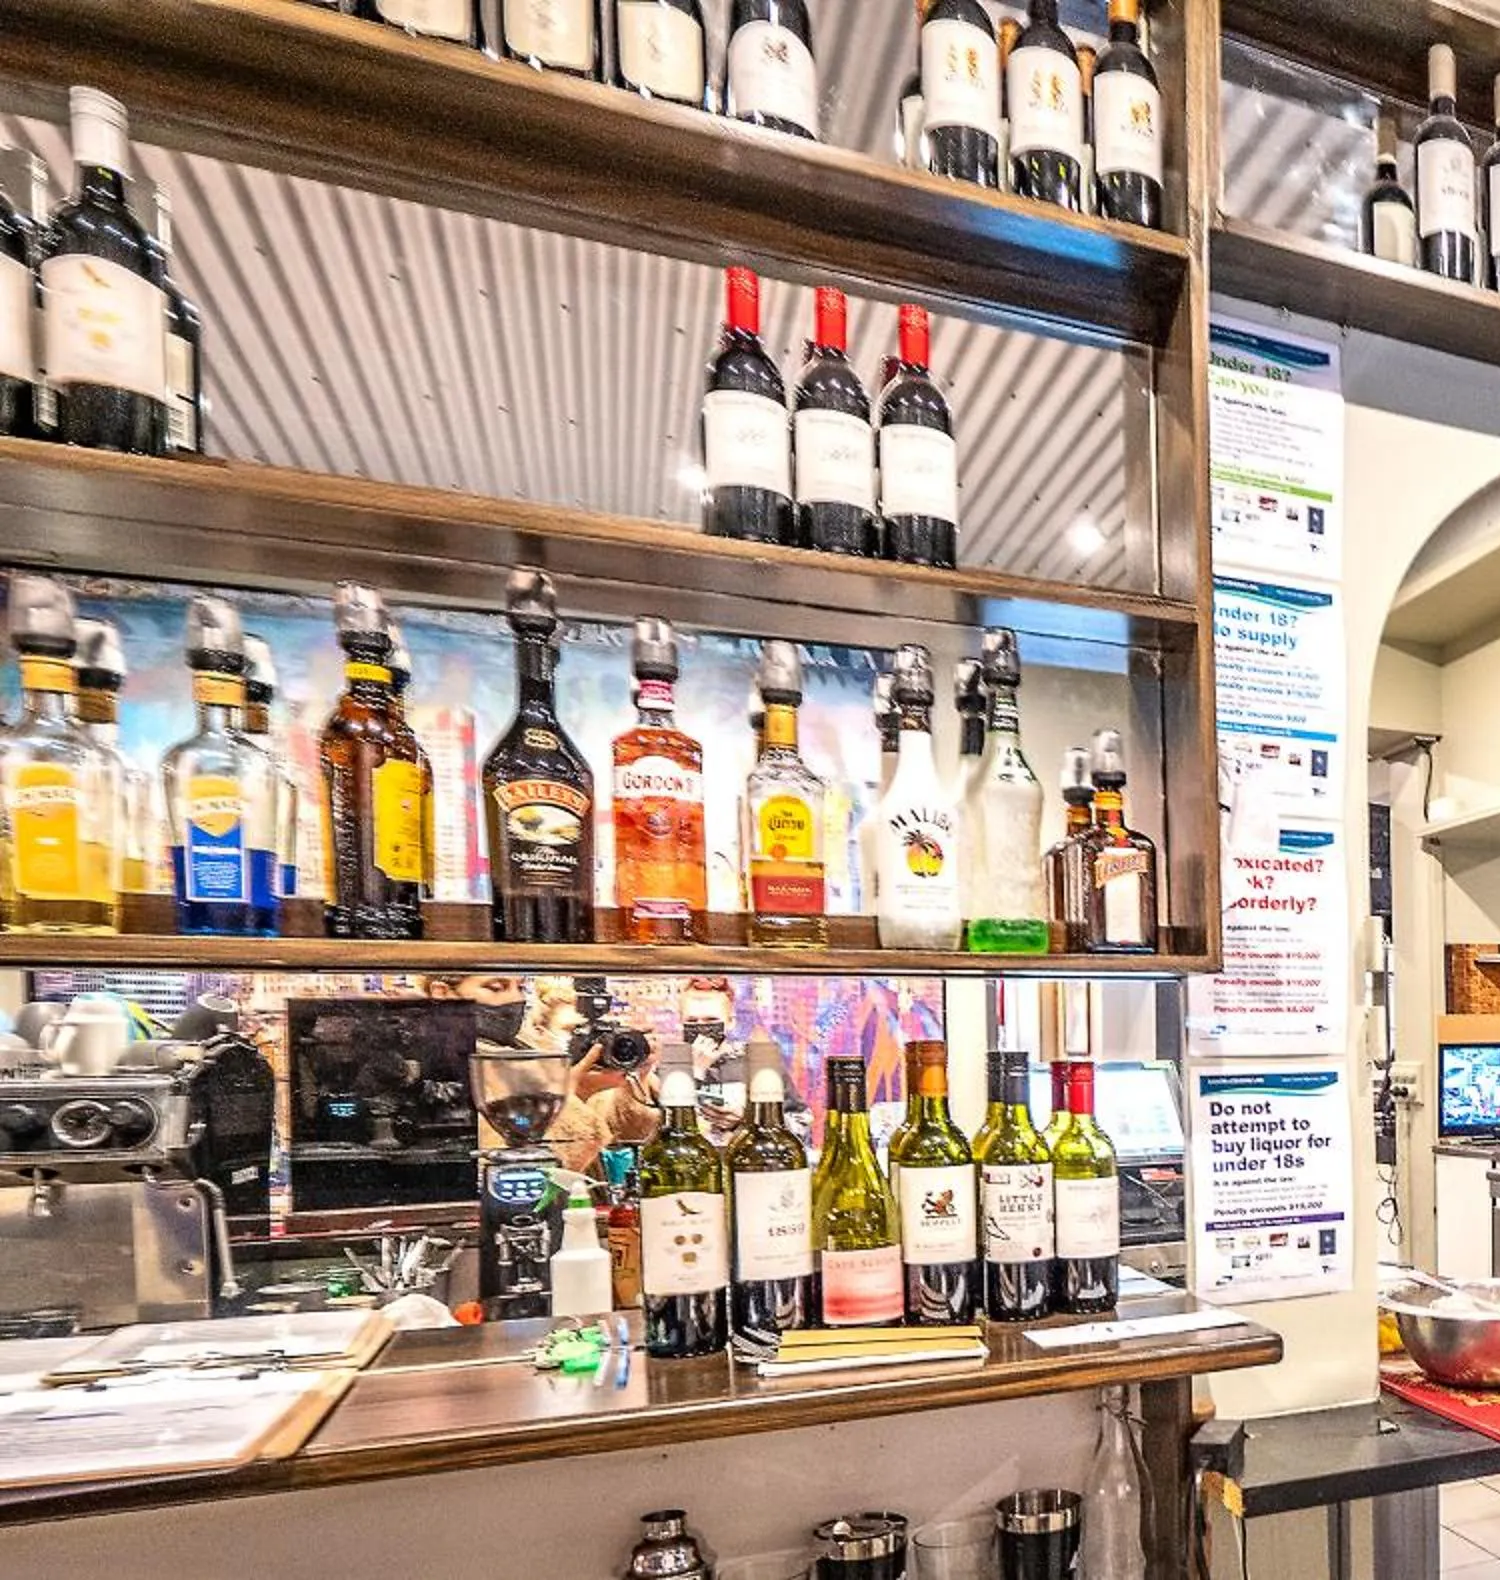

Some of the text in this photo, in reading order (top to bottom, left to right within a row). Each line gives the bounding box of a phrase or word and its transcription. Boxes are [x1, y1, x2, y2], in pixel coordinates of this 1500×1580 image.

[1270, 611, 1298, 629] 18?
[1236, 629, 1298, 651] supply
[1209, 1100, 1272, 1117] Do not
[1211, 1117, 1311, 1136] attempt to
[1211, 1133, 1332, 1157] buy liquor for
[1213, 1153, 1305, 1173] under 18s
